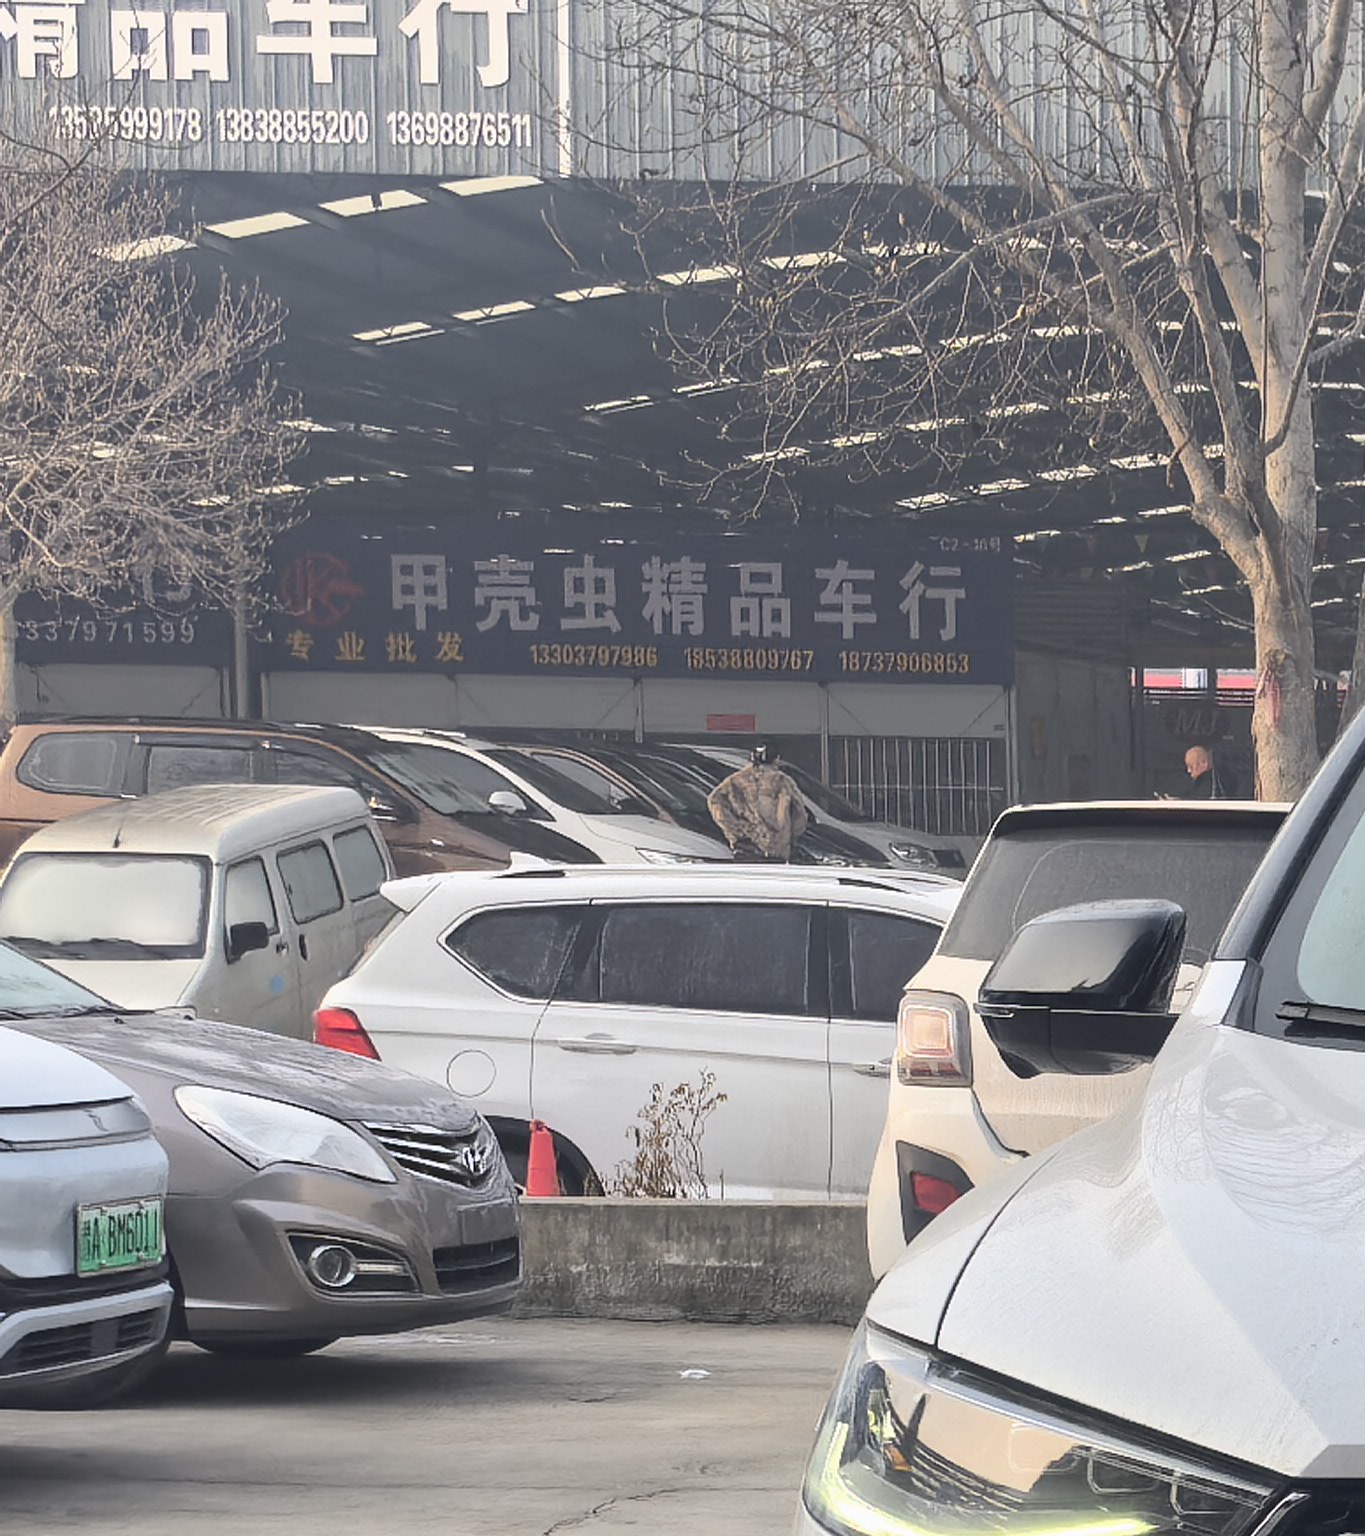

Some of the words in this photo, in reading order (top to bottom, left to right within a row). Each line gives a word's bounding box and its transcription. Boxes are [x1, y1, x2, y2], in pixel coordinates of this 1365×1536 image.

[215, 107, 369, 145] 13838855200
[386, 111, 533, 147] 13698876511
[390, 553, 966, 642] 甲壳虫精品车行
[285, 631, 464, 664] 专业批发
